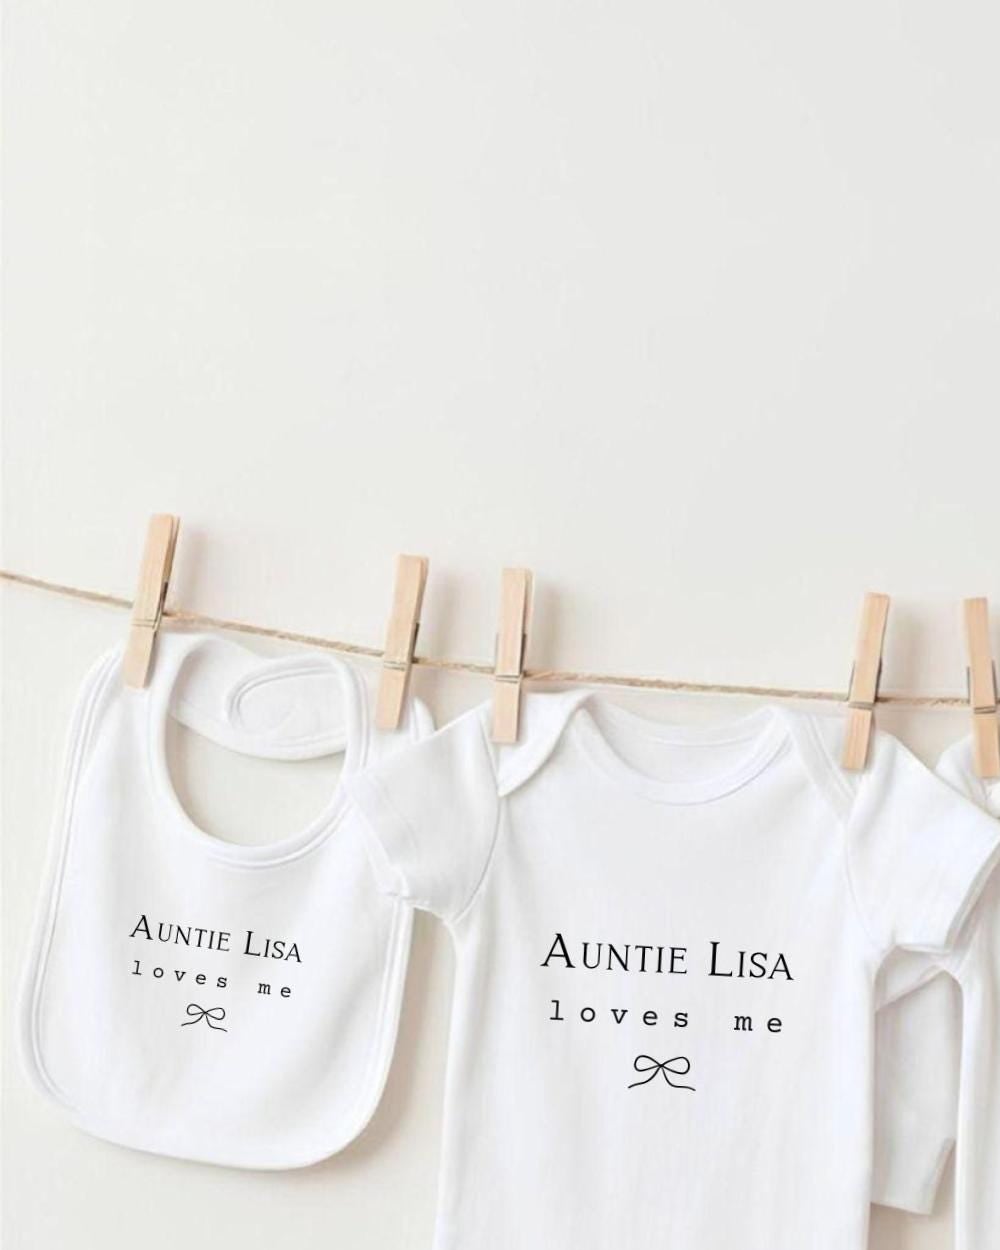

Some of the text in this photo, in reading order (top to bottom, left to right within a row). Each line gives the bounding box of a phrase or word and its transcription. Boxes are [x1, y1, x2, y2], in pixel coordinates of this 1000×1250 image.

[130, 914, 302, 964] AUNTIE LISA
[541, 932, 794, 981] AUNTIE LISA
[132, 959, 293, 999] loves me
[549, 999, 783, 1034] loves me
